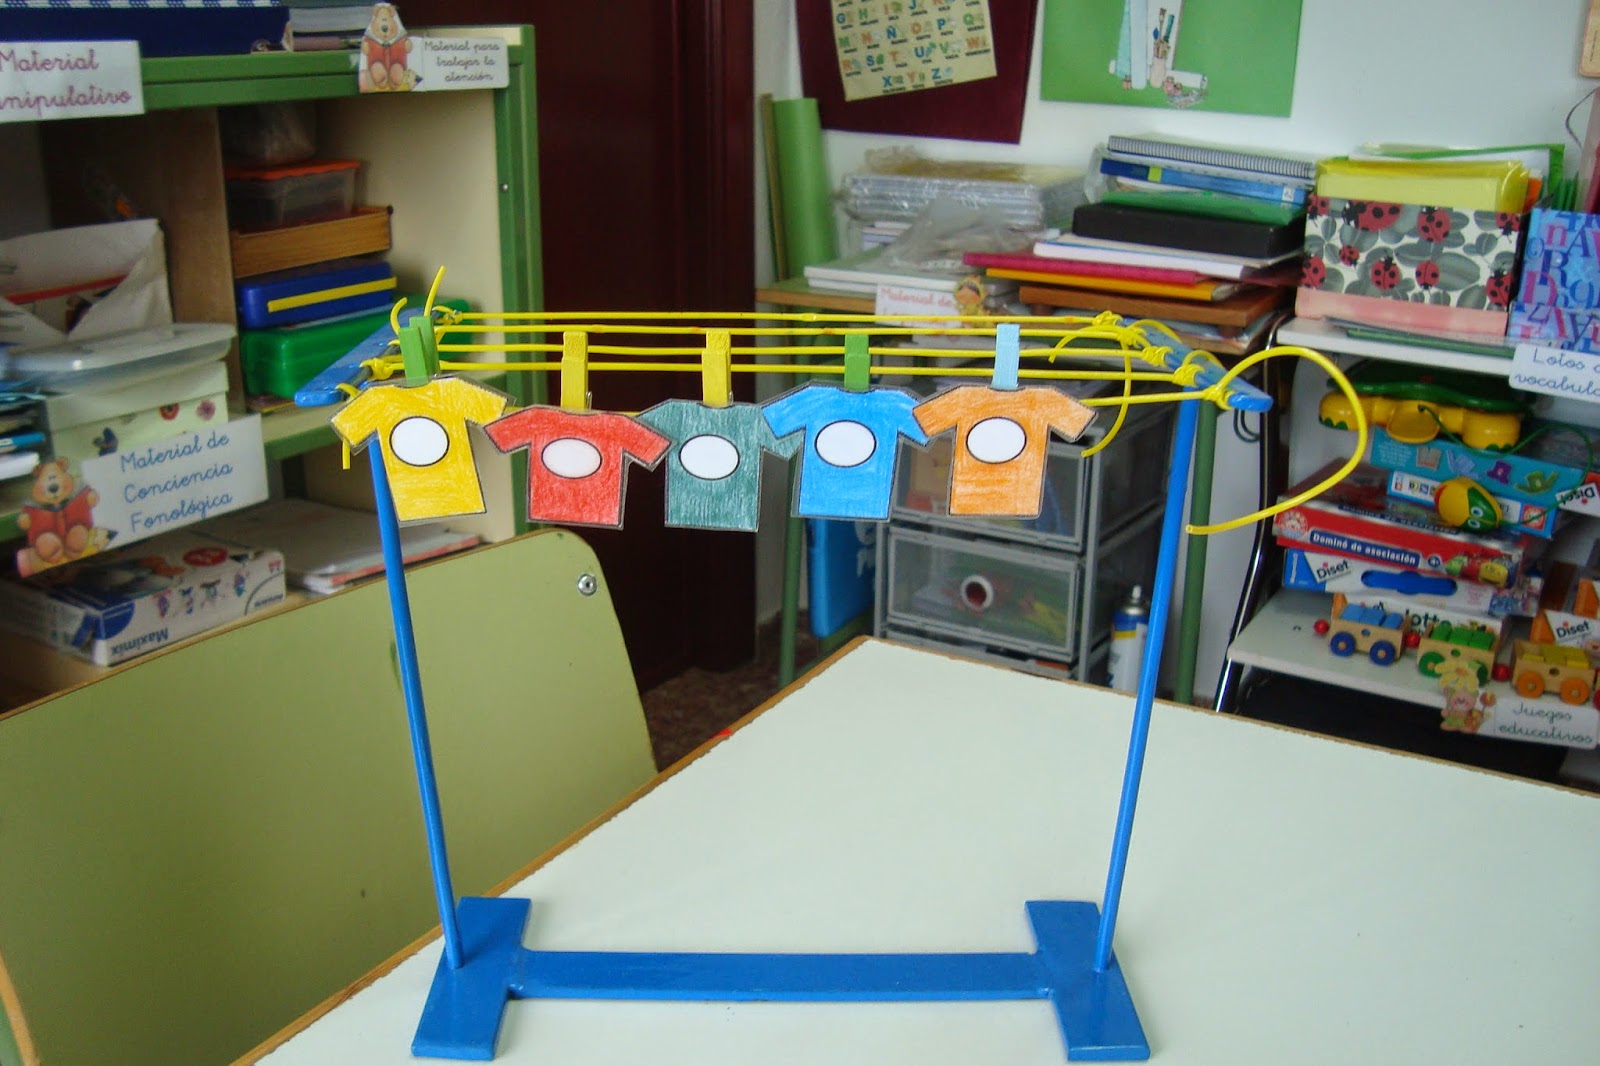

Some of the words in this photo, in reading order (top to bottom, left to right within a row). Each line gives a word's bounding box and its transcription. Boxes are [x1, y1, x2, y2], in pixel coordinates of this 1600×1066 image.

[424, 40, 469, 52] Material
[474, 43, 500, 53] para
[0, 48, 99, 72] Material
[483, 54, 496, 66] la
[0, 85, 132, 117] nipulativo
[1533, 347, 1585, 370] Lotos
[120, 432, 202, 472] Material
[206, 429, 229, 448] de
[124, 461, 233, 503] Conciencia
[130, 492, 233, 533] Fonológica
[1313, 533, 1348, 550] Dominó
[1351, 541, 1363, 552] de
[1365, 546, 1416, 565] asociación
[1316, 558, 1349, 580] Diset
[1556, 619, 1590, 638] Diset
[111, 627, 169, 655] Maximix
[1512, 702, 1572, 724] Juegos
[1498, 723, 1594, 745] educativos
